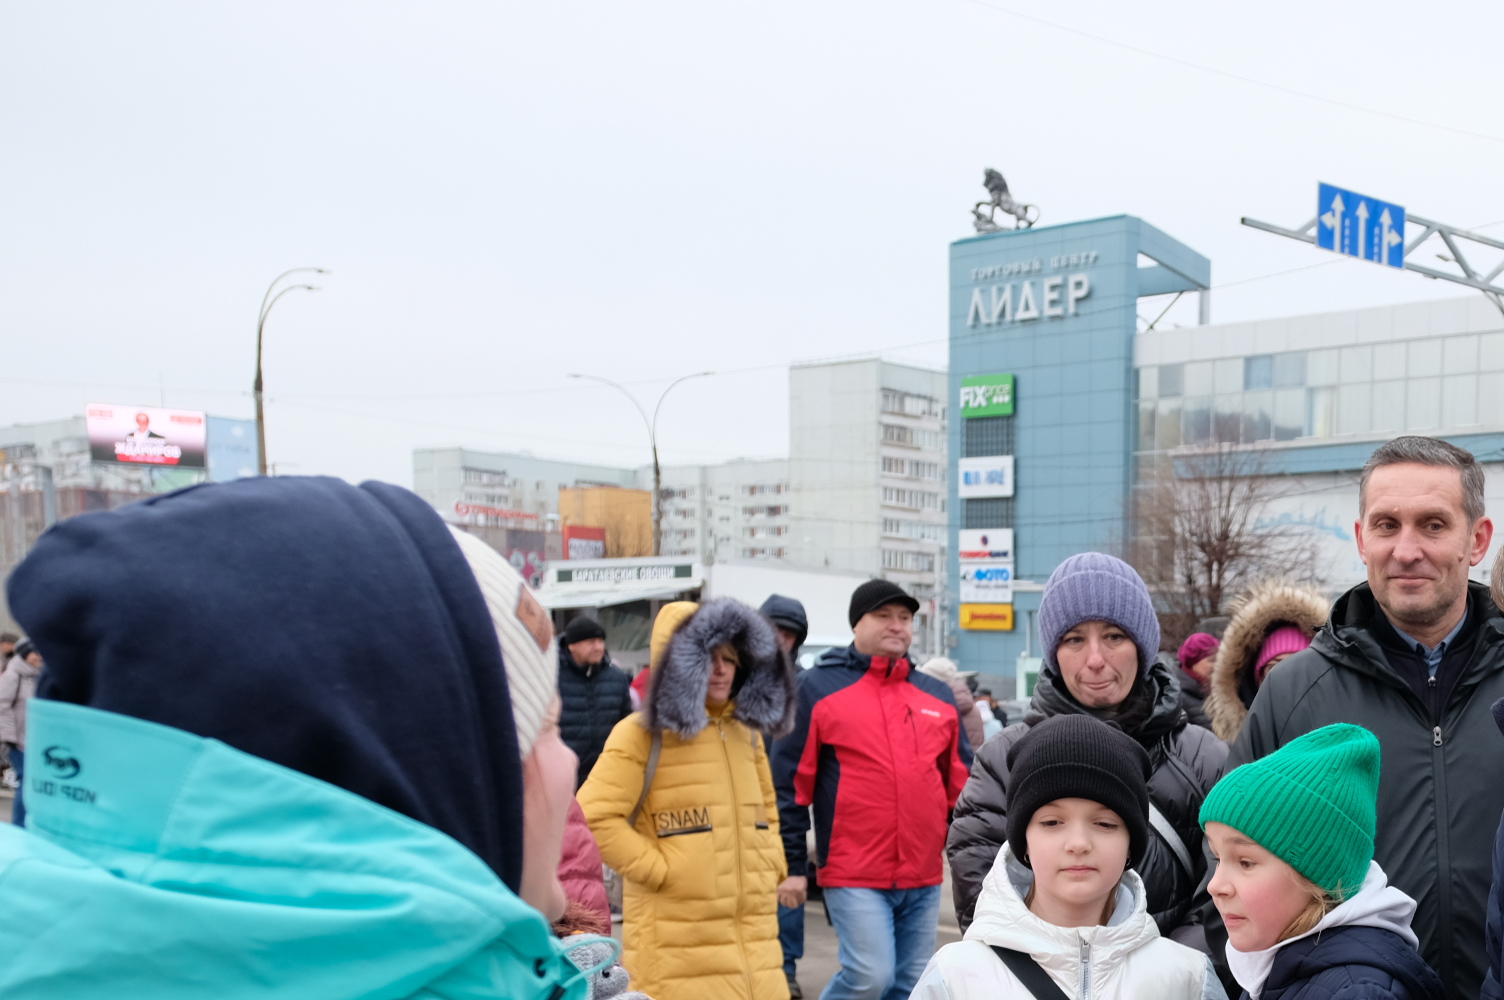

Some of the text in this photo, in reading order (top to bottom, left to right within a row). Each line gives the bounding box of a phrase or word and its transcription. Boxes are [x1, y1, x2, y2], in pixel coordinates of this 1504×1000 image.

[971, 250, 1099, 280] ТОРГОВЫЙ ЦЕНТР
[966, 271, 1092, 327] ЛИДЕР
[571, 565, 675, 583] БАРАТАЕВСКИЕ ОВОЩИ
